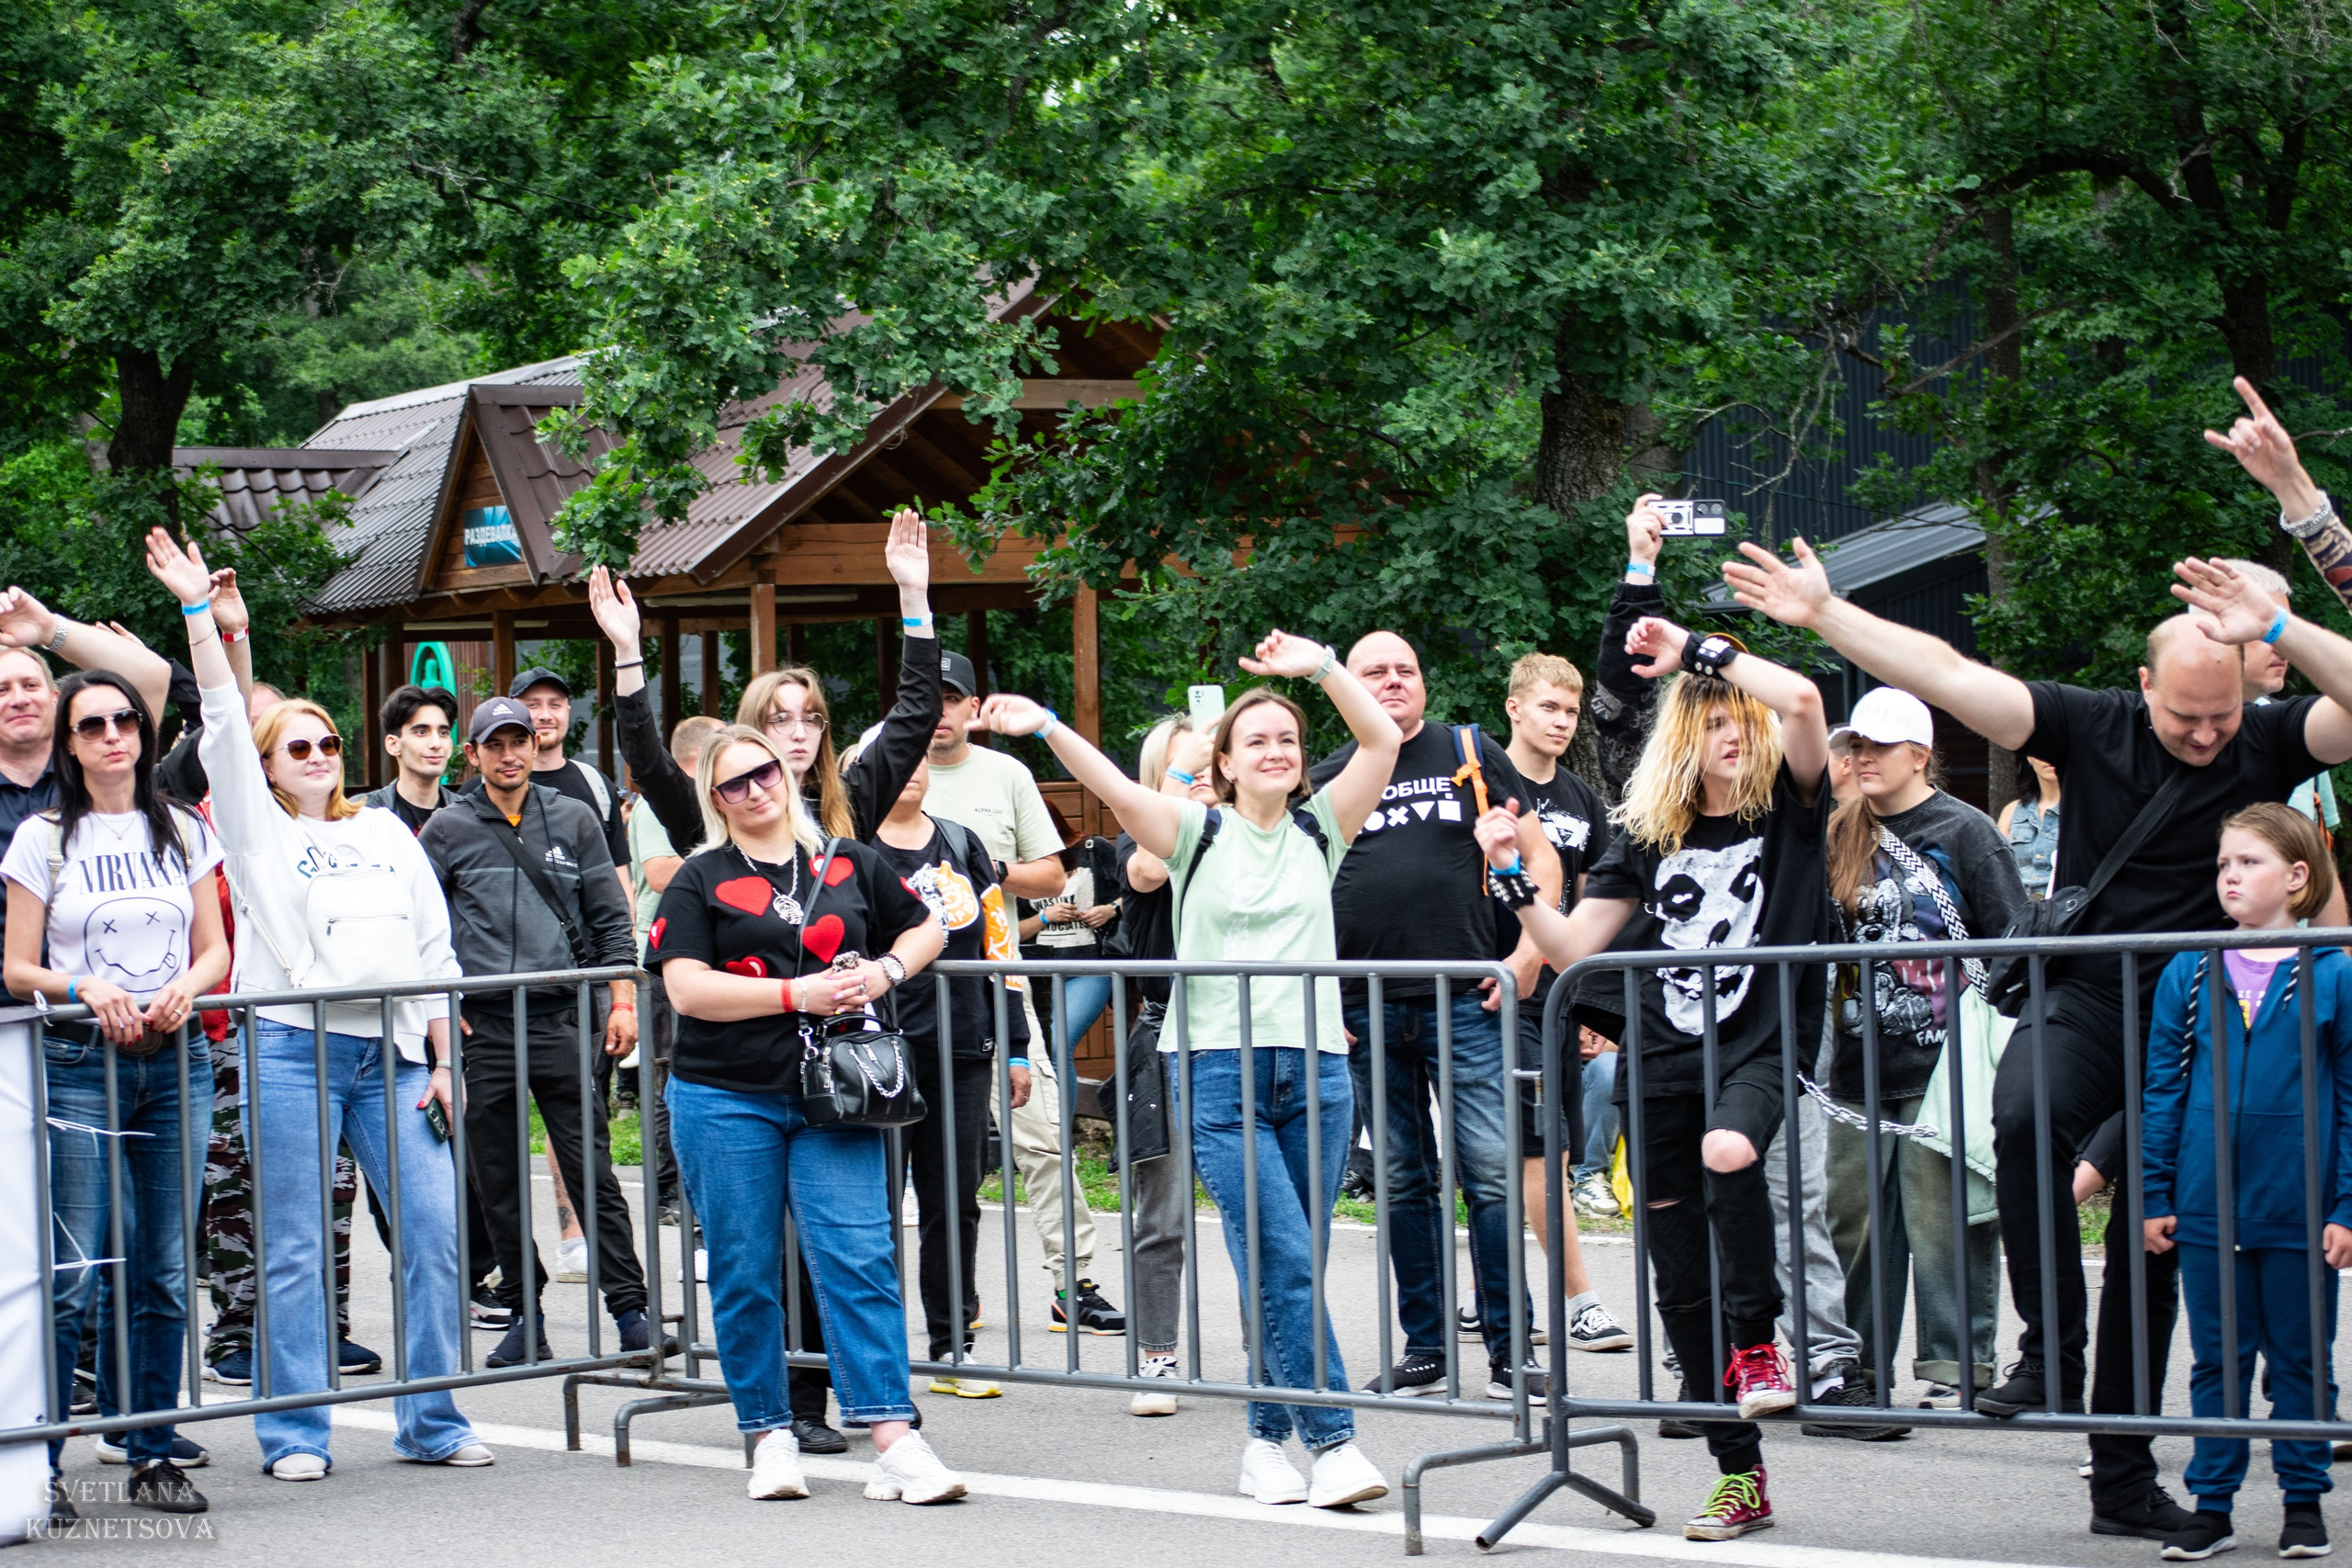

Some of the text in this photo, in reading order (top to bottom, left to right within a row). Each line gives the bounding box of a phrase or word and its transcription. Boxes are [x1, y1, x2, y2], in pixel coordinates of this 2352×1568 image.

[464, 524, 518, 547] РАЗДЕВАЛКА
[1381, 776, 1452, 801] ОБЩЕ
[78, 850, 185, 895] NIRVANA
[1916, 1029, 1947, 1046] FAN
